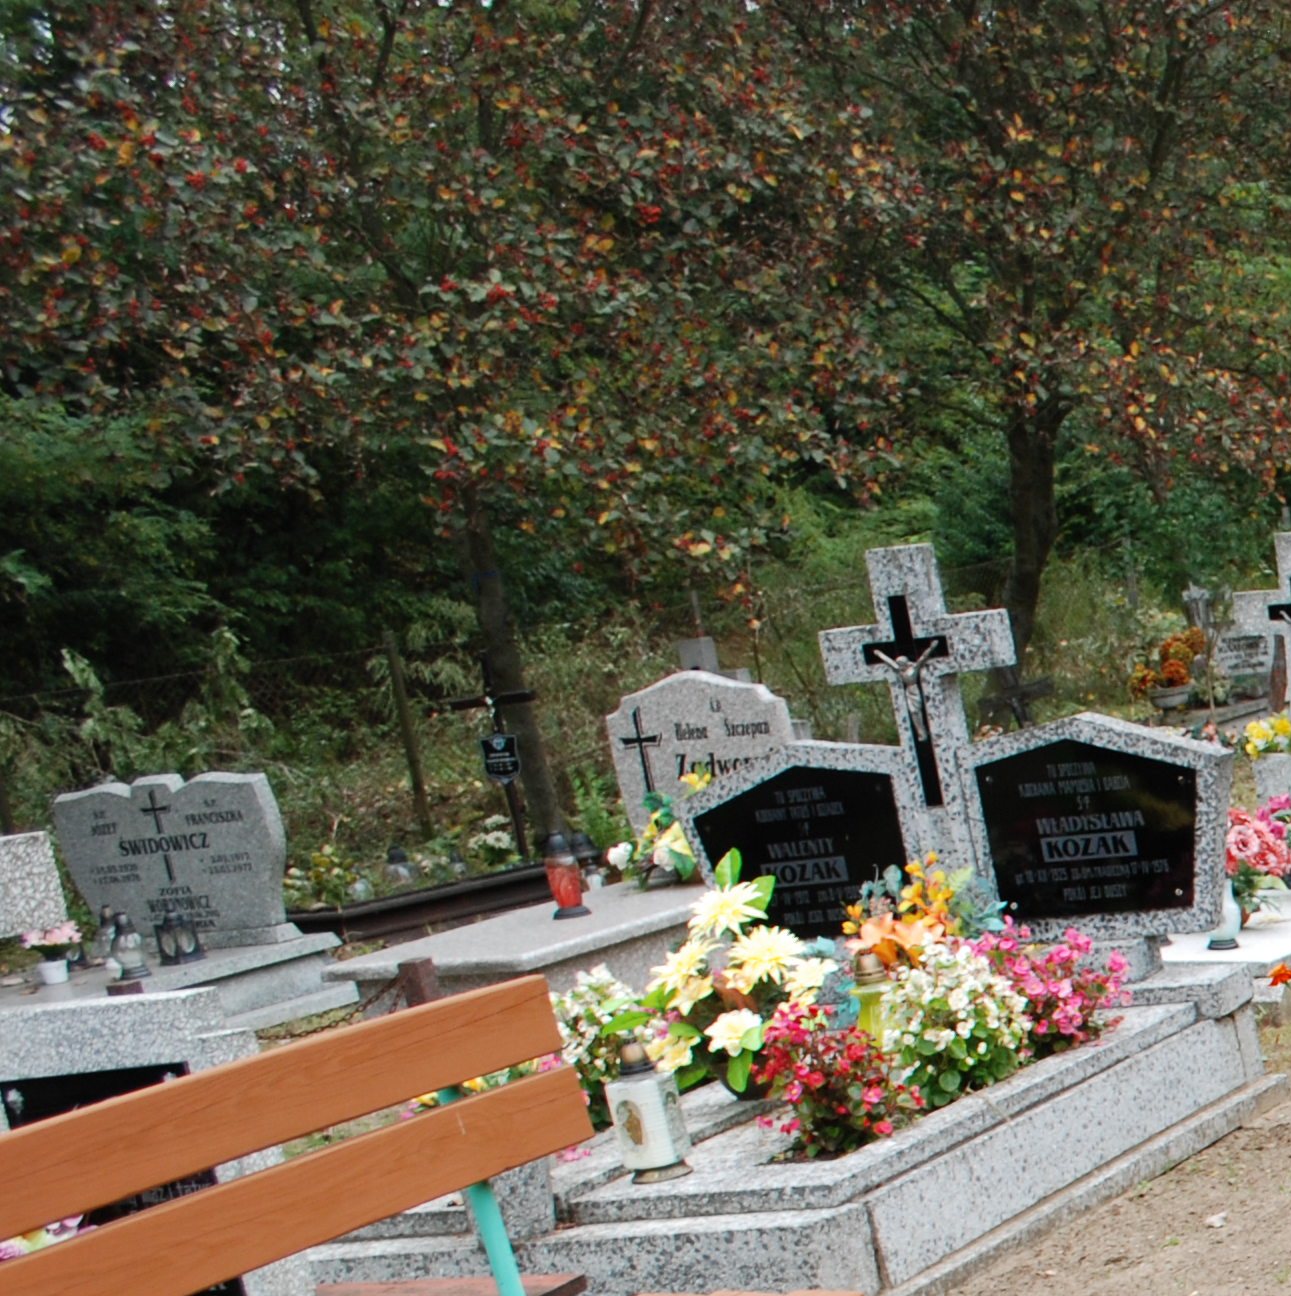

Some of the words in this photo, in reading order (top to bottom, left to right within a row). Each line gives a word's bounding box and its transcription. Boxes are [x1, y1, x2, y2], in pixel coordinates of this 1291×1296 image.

[1035, 809, 1146, 835] WŁADYSŁAWA
[119, 832, 210, 857] ŚWIDOWICZ
[767, 837, 834, 859] WALENTY
[1046, 834, 1130, 860] KOZAK
[765, 861, 842, 885] KOZAK
